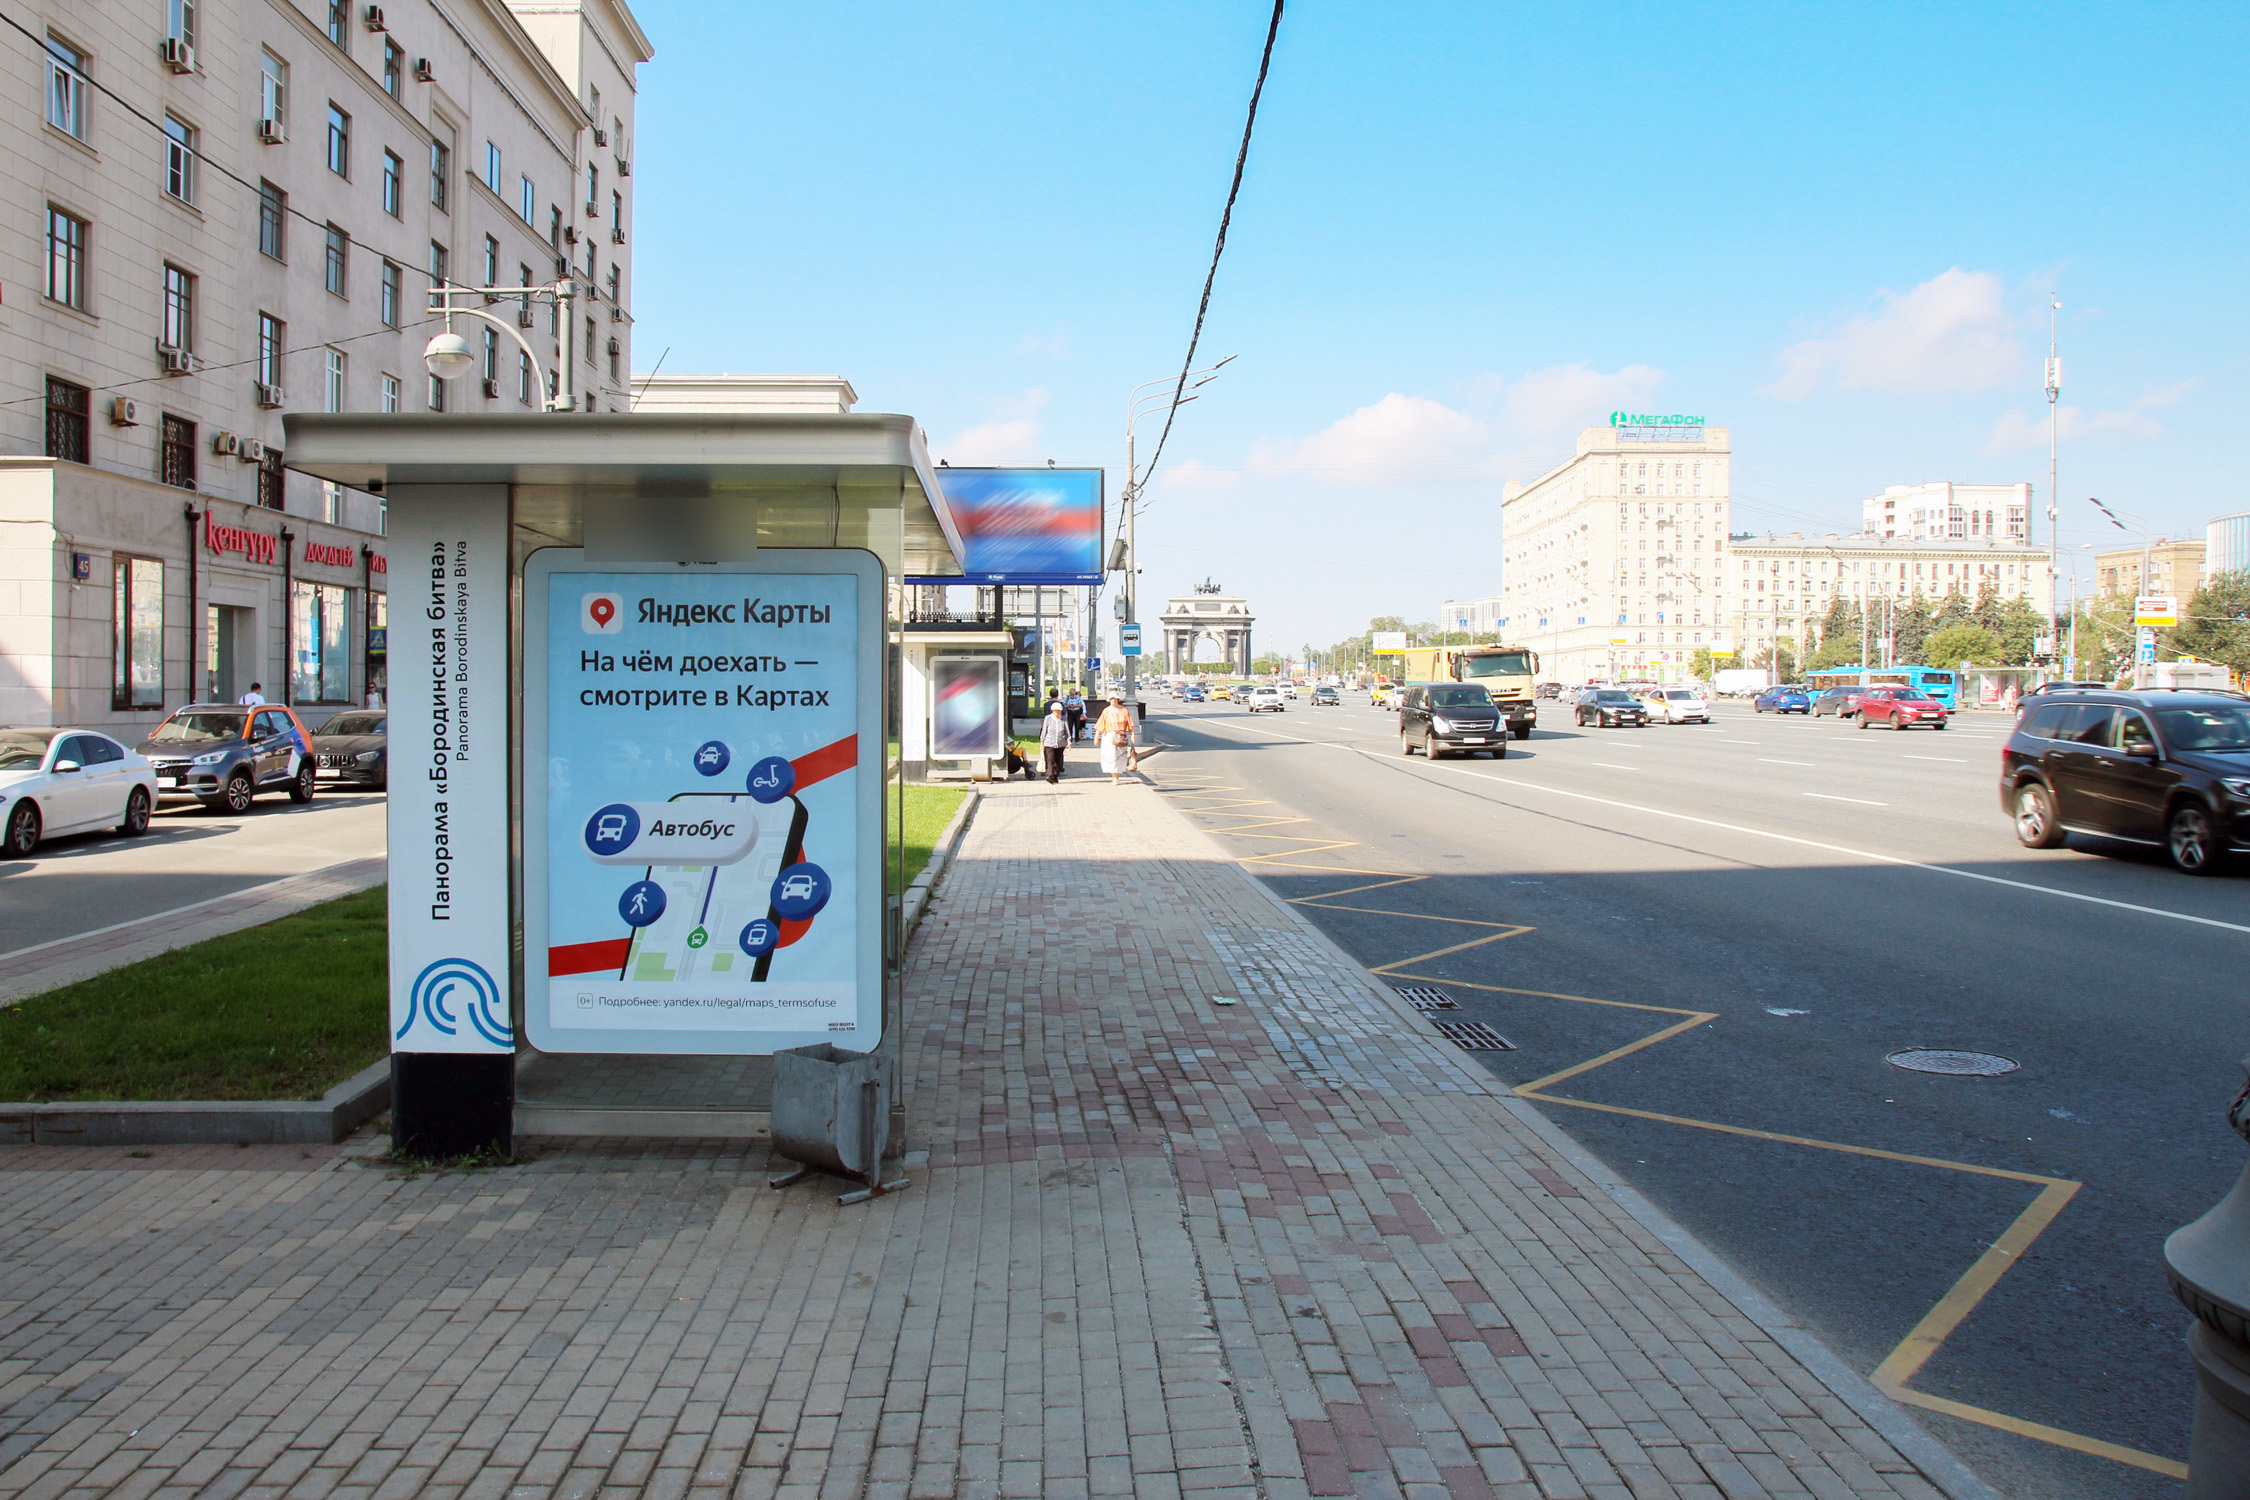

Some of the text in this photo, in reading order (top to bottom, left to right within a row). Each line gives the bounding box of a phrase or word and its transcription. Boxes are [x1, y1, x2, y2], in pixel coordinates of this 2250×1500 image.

[78, 560, 89, 574] 45
[305, 542, 326, 563] ДЛЯ
[326, 545, 354, 567] ДЕТЕЙ
[637, 597, 831, 628] Яндекс Карты
[454, 541, 471, 761] Panorama Borodinskaya Bitva
[580, 650, 614, 672] На
[622, 650, 673, 672] чём
[680, 654, 787, 676] доехать
[580, 684, 830, 711] смотрите в Картах
[426, 541, 454, 921] Панорама «Бородинская битва»
[648, 819, 736, 840] Автобус
[580, 997, 590, 1005] 0+
[598, 996, 837, 1010] Подробнее: yandex.ru/legal/maps_termsofuse
